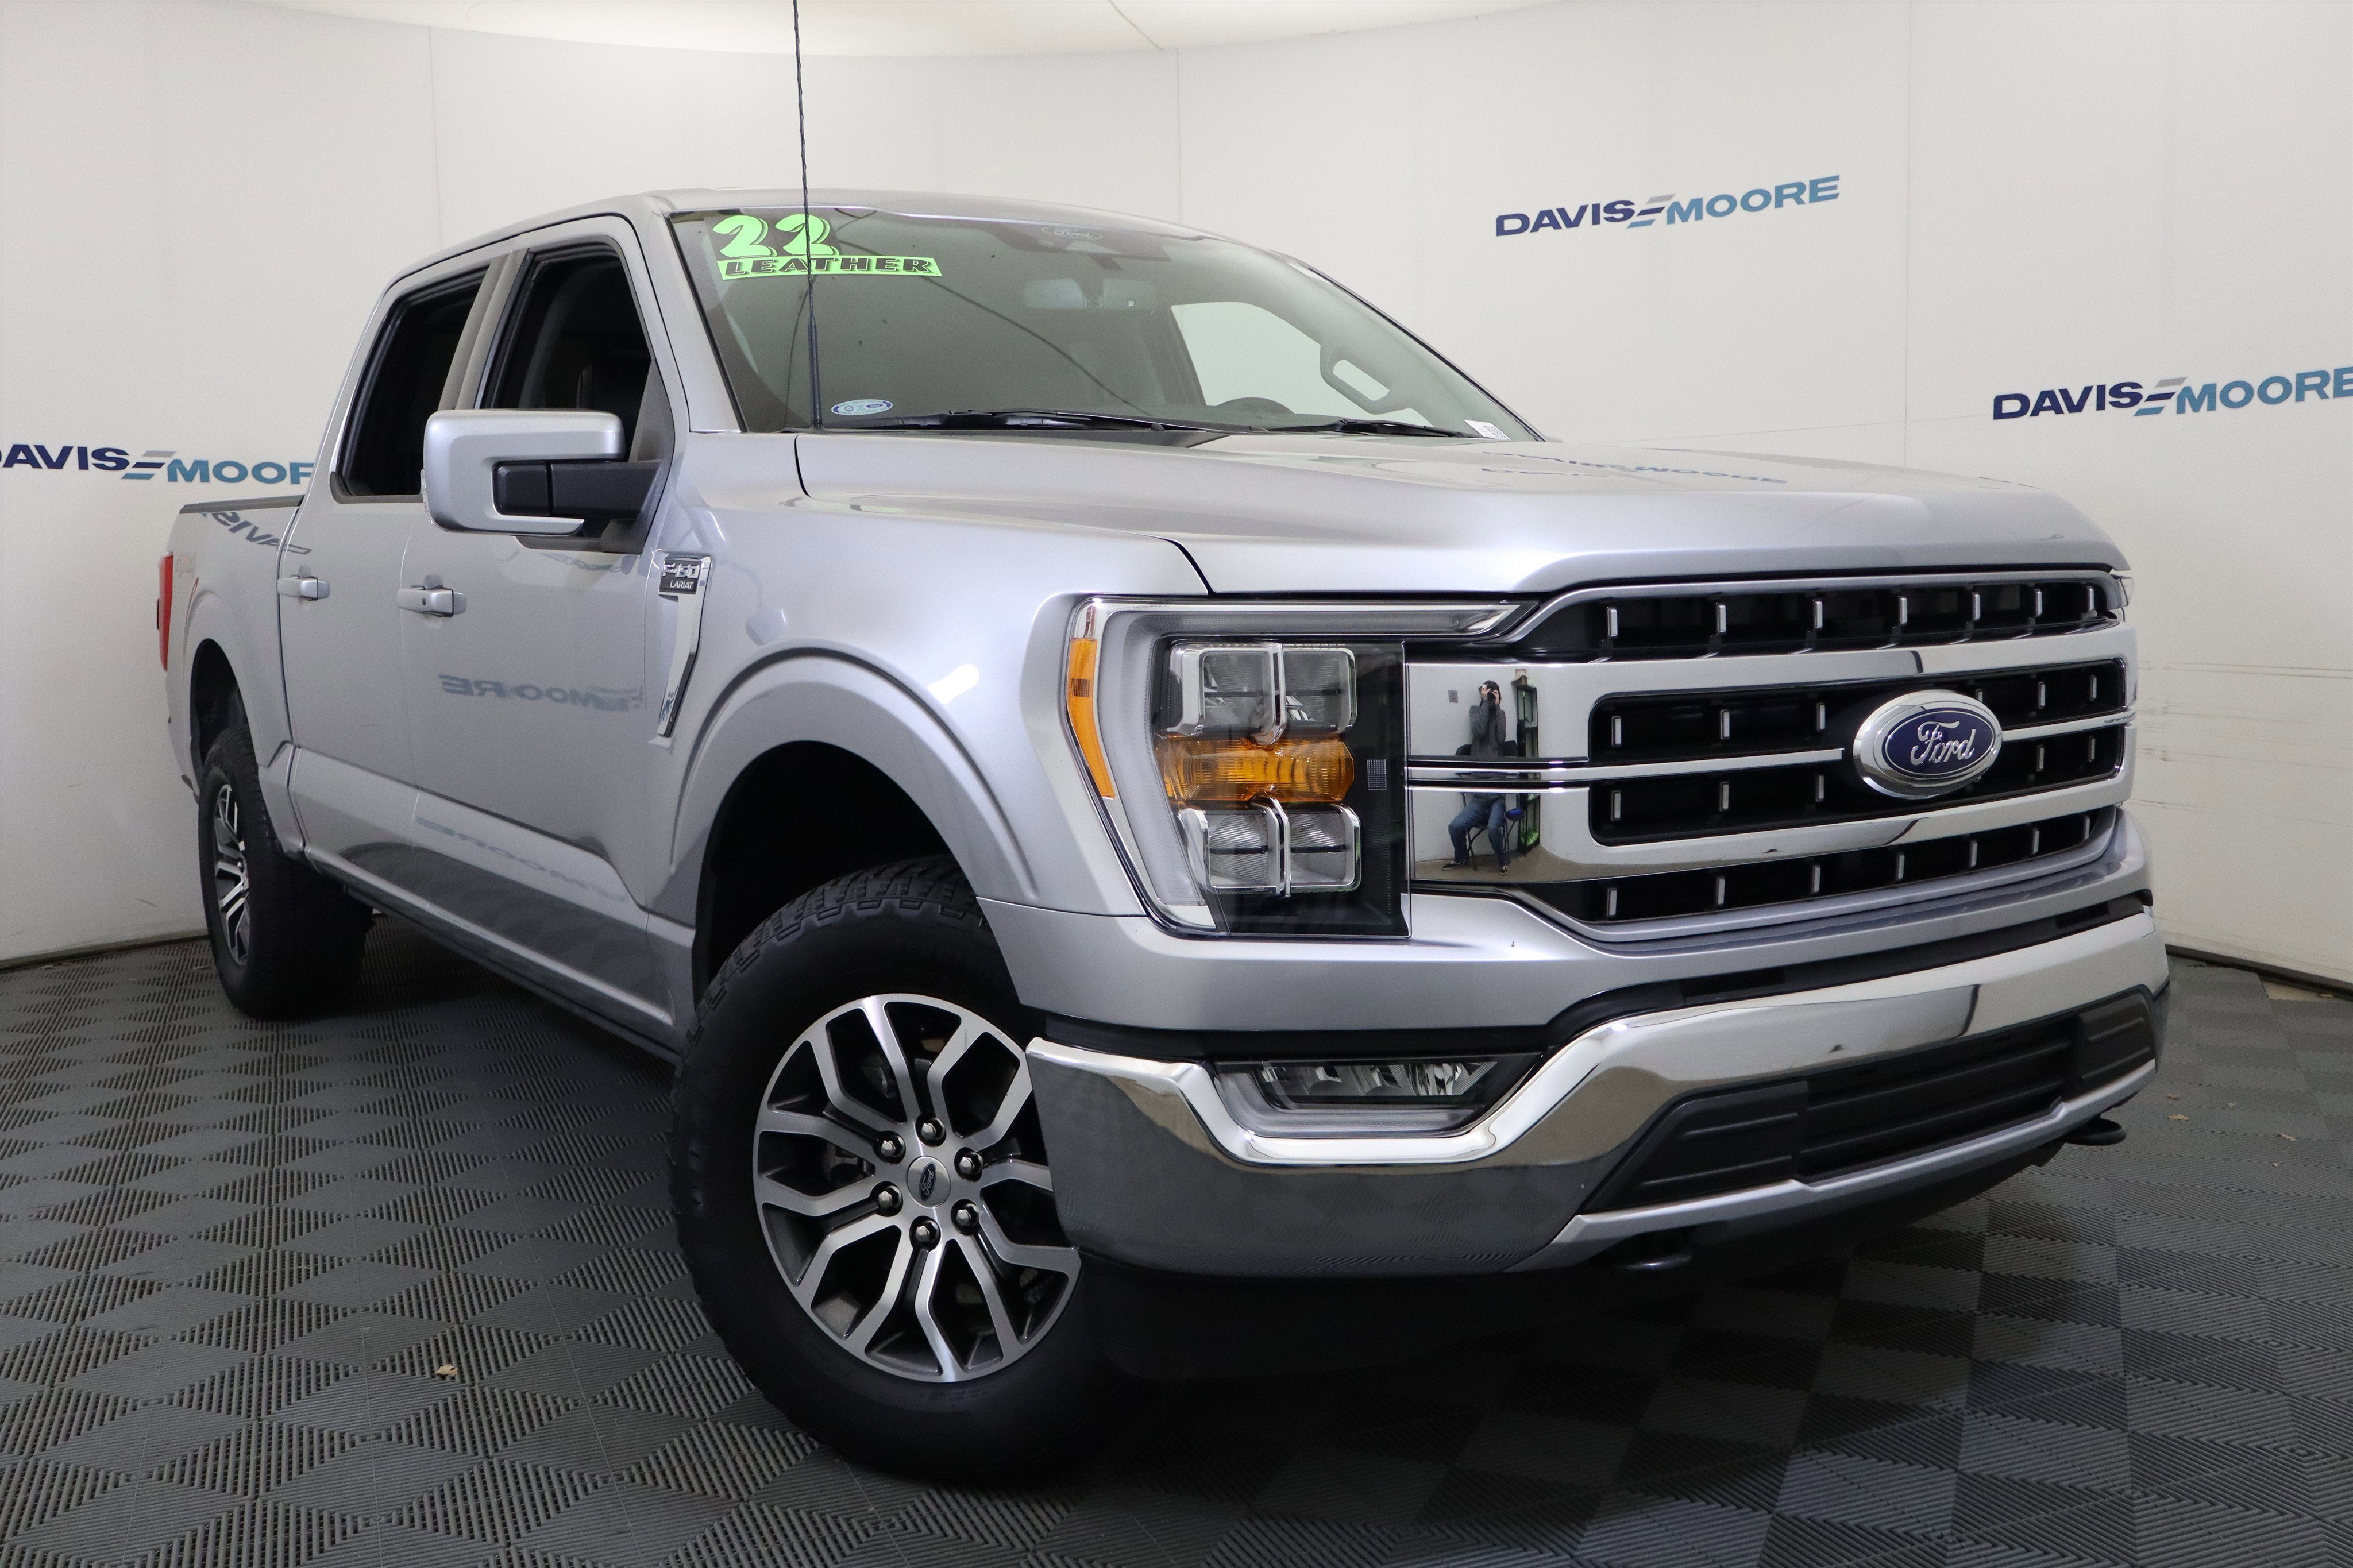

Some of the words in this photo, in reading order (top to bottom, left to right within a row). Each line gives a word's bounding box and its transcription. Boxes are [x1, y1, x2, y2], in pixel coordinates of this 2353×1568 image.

[1495, 199, 1635, 237] DAVIS
[1666, 175, 1840, 225] MOORE
[712, 213, 840, 258] 22
[725, 257, 932, 276] LEATHER
[1993, 381, 2143, 420] DAVIS
[2175, 366, 2353, 415] MOORE
[0, 443, 130, 470] AVIS
[167, 459, 316, 485] MOOR
[670, 580, 694, 589] LARIAT
[1910, 720, 1977, 766] Ford
[921, 1168, 935, 1195] Ford
